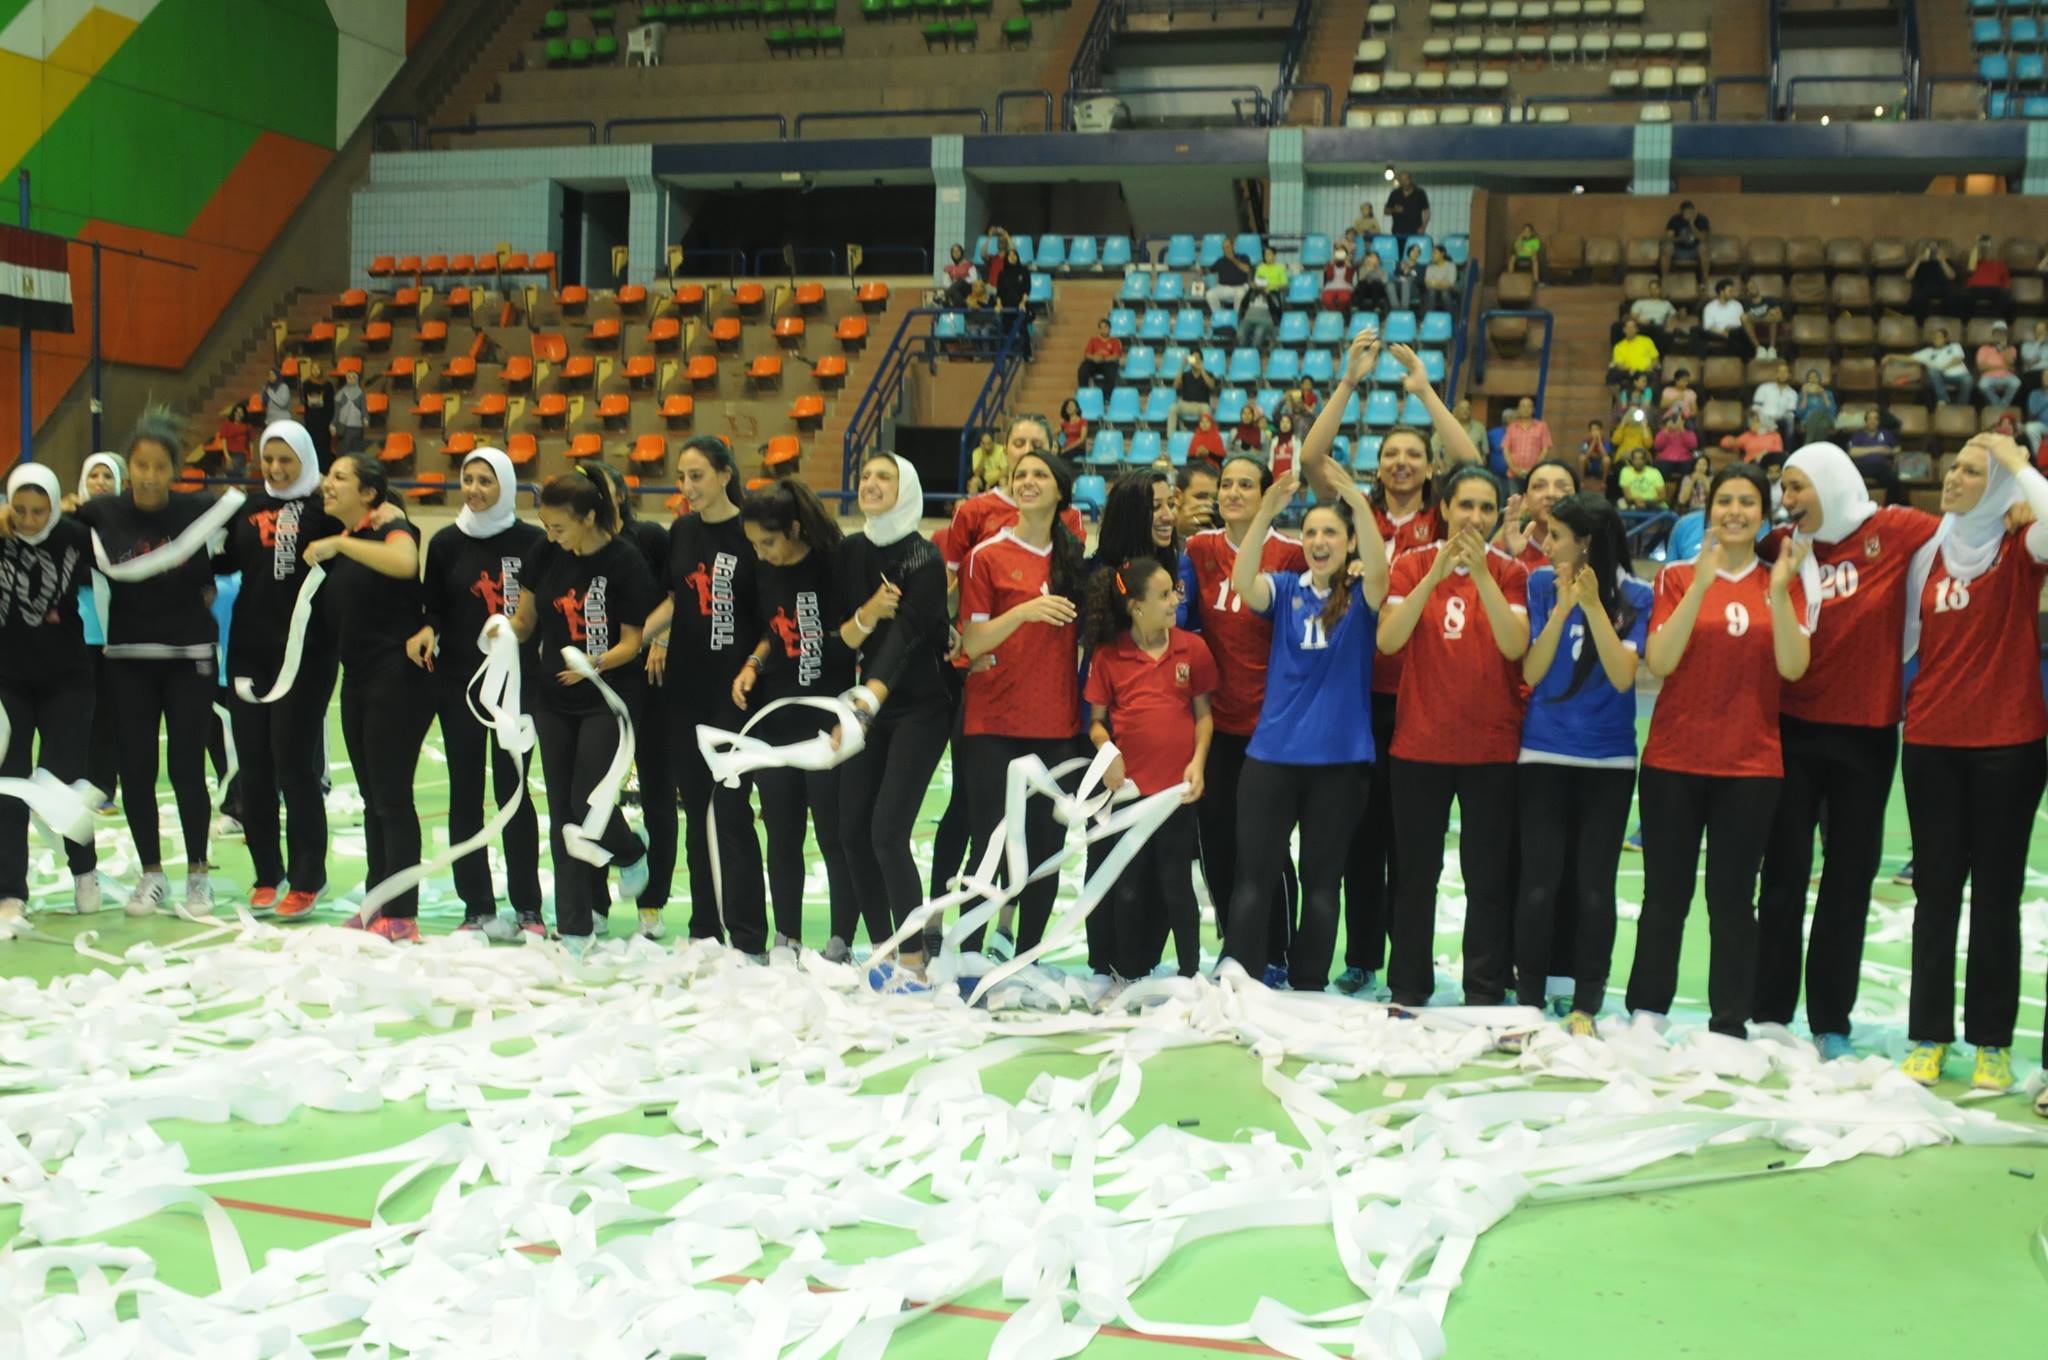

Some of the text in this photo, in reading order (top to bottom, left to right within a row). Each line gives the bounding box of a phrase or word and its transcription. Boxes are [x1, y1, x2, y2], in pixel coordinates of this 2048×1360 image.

[1818, 561, 1859, 599] 20
[711, 552, 738, 650] HANDBALL
[1444, 596, 1466, 633] 8
[1725, 602, 1750, 637] 9
[796, 592, 823, 686] HANDBALL
[1300, 614, 1329, 650] 11
